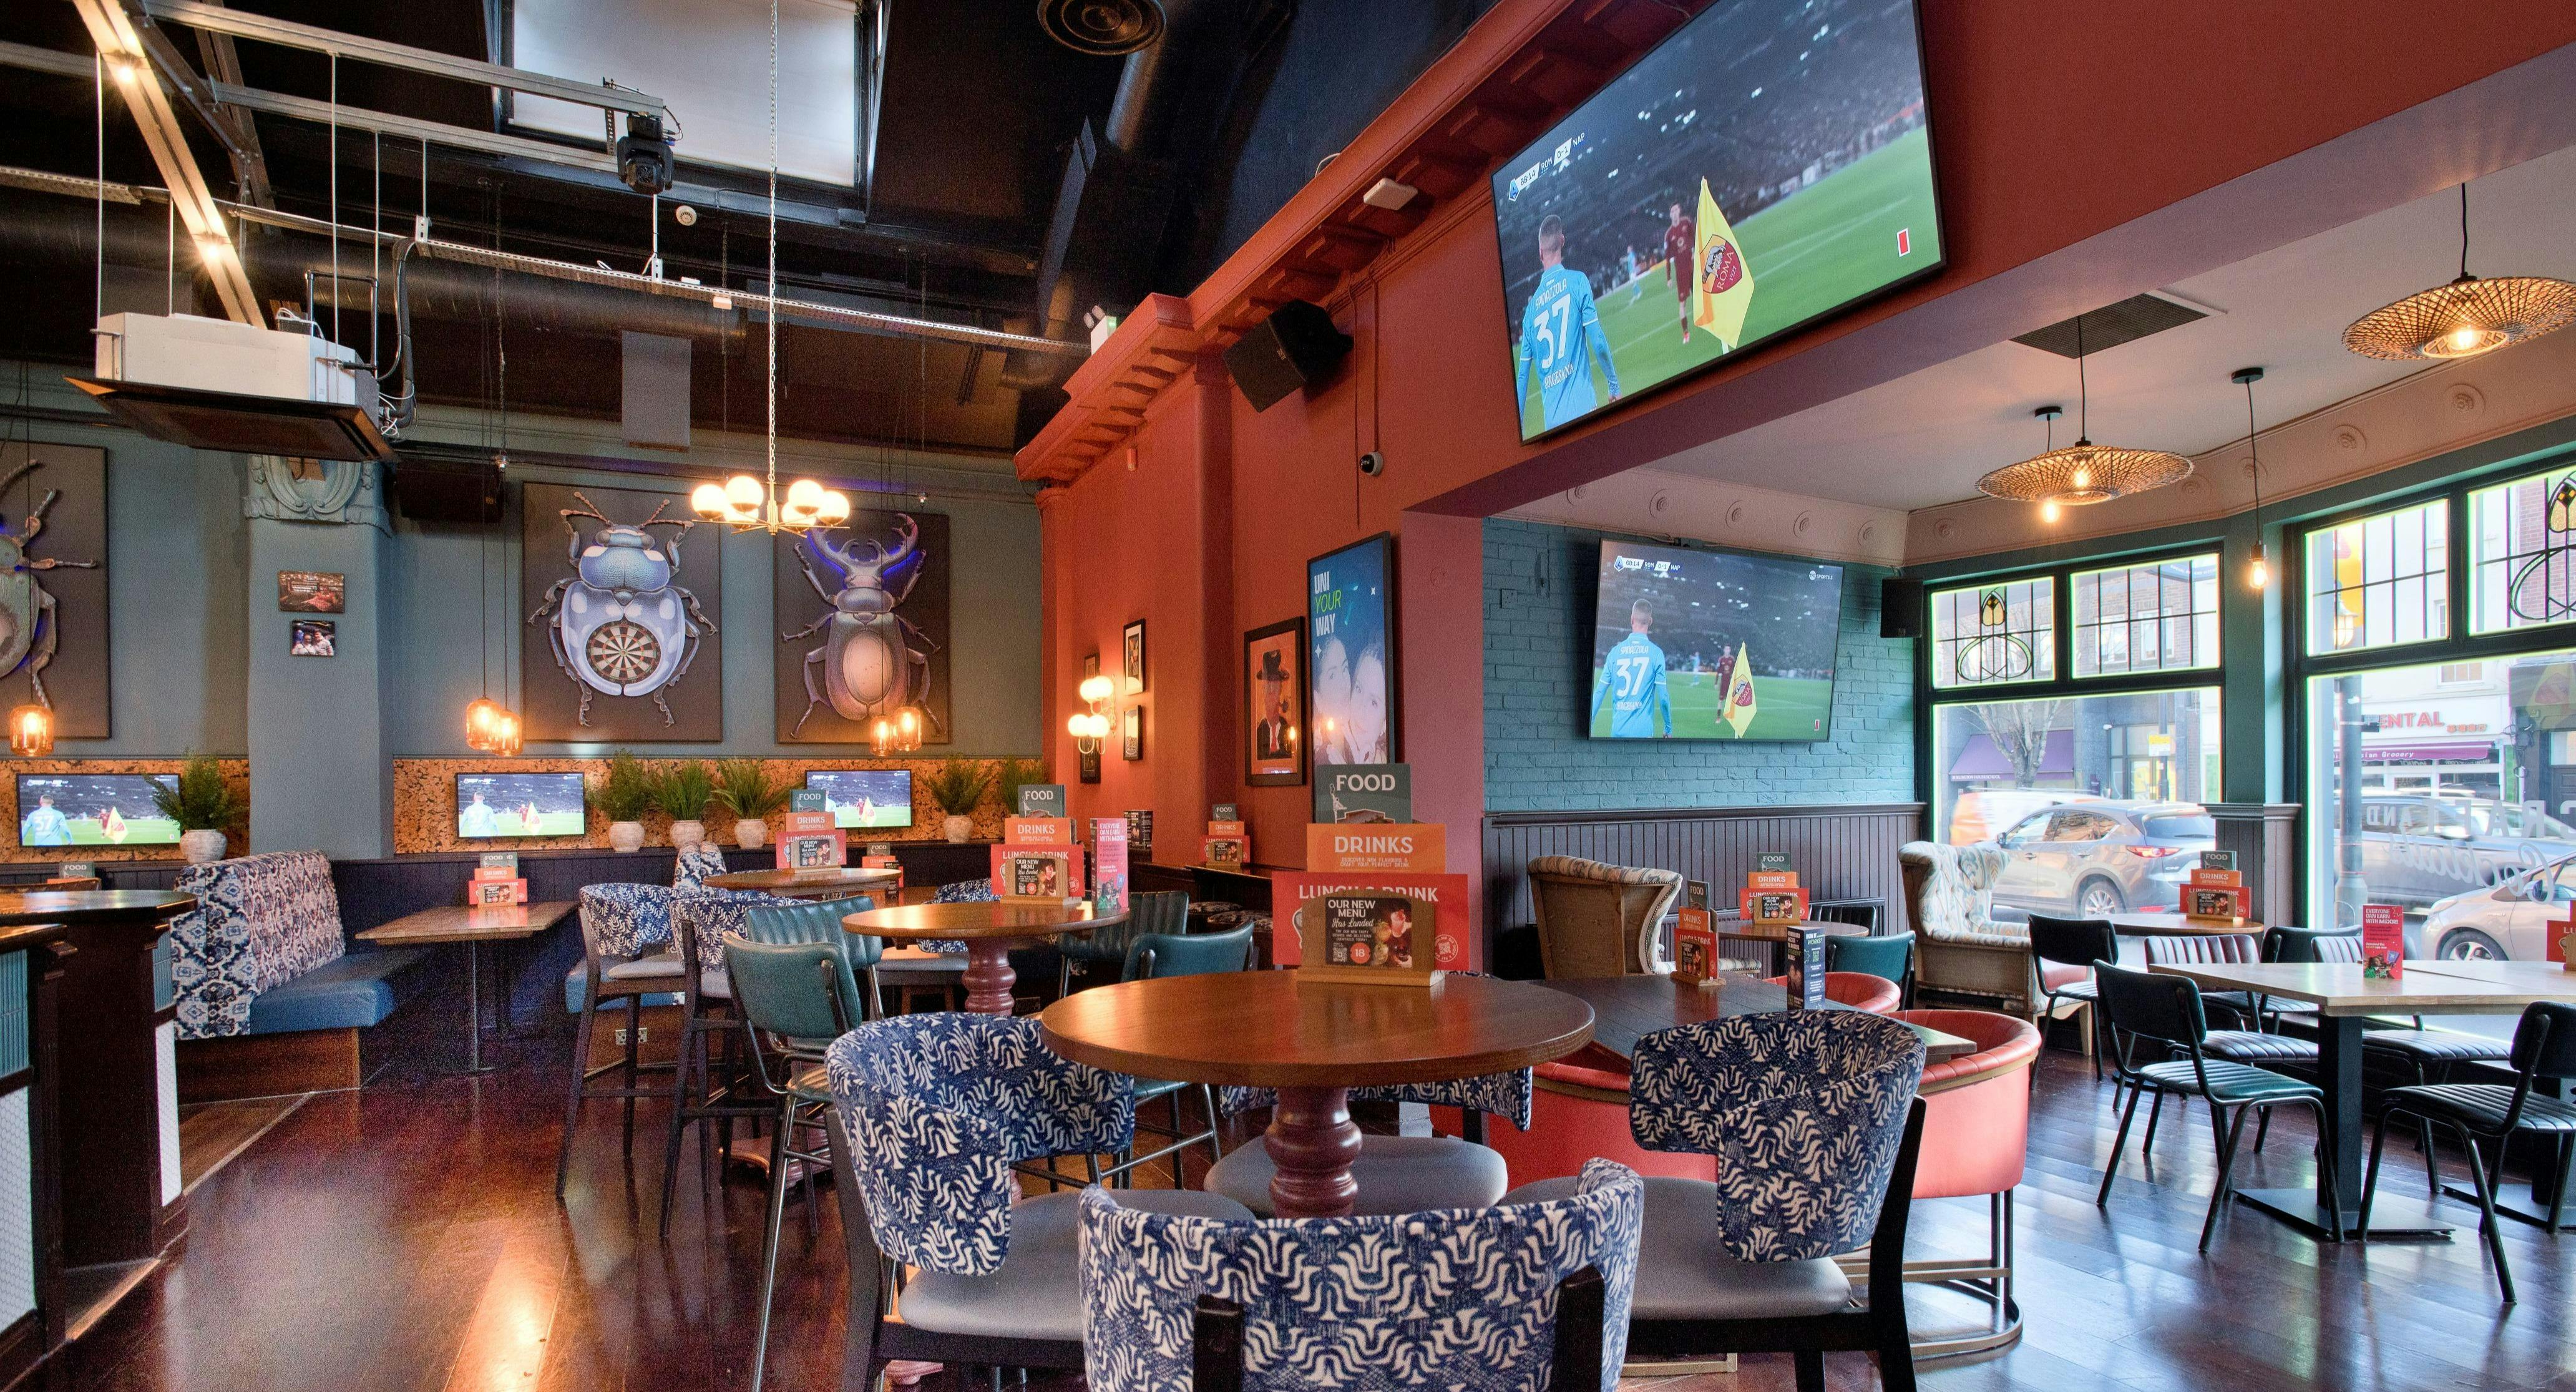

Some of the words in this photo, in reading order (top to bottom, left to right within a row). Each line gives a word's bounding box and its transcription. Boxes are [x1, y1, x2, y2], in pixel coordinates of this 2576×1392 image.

[1520, 170, 1536, 186] 68:14
[1541, 156, 1553, 171] ROM
[1557, 146, 1568, 158] 0-1
[1573, 132, 1585, 147] NAP
[1717, 251, 1734, 290] ROMA
[1535, 278, 1567, 311] SPINAZZOLA
[1534, 293, 1571, 369] 37
[1314, 571, 1330, 594] UNI
[1315, 590, 1341, 614] YOUR
[1315, 613, 1335, 637] WAY
[1616, 657, 1649, 697] 37
[1739, 688, 1751, 705] ROMA
[2381, 751, 2414, 759] Grocery
[1336, 774, 1395, 792] FOOD
[1025, 791, 1053, 800] FOOD
[34, 815, 54, 831] 37
[1018, 824, 1055, 834] DRINKS
[1335, 836, 1413, 854] DRINKS
[1690, 886, 1704, 895] FOOD
[1328, 900, 1350, 909] OUR
[1351, 900, 1375, 909] NEW
[1338, 909, 1366, 918] MENU
[1684, 913, 1701, 924] DRINKS
[1332, 918, 1346, 928] Has
[1348, 917, 1374, 927] Landed
[1355, 949, 1365, 957] 18
